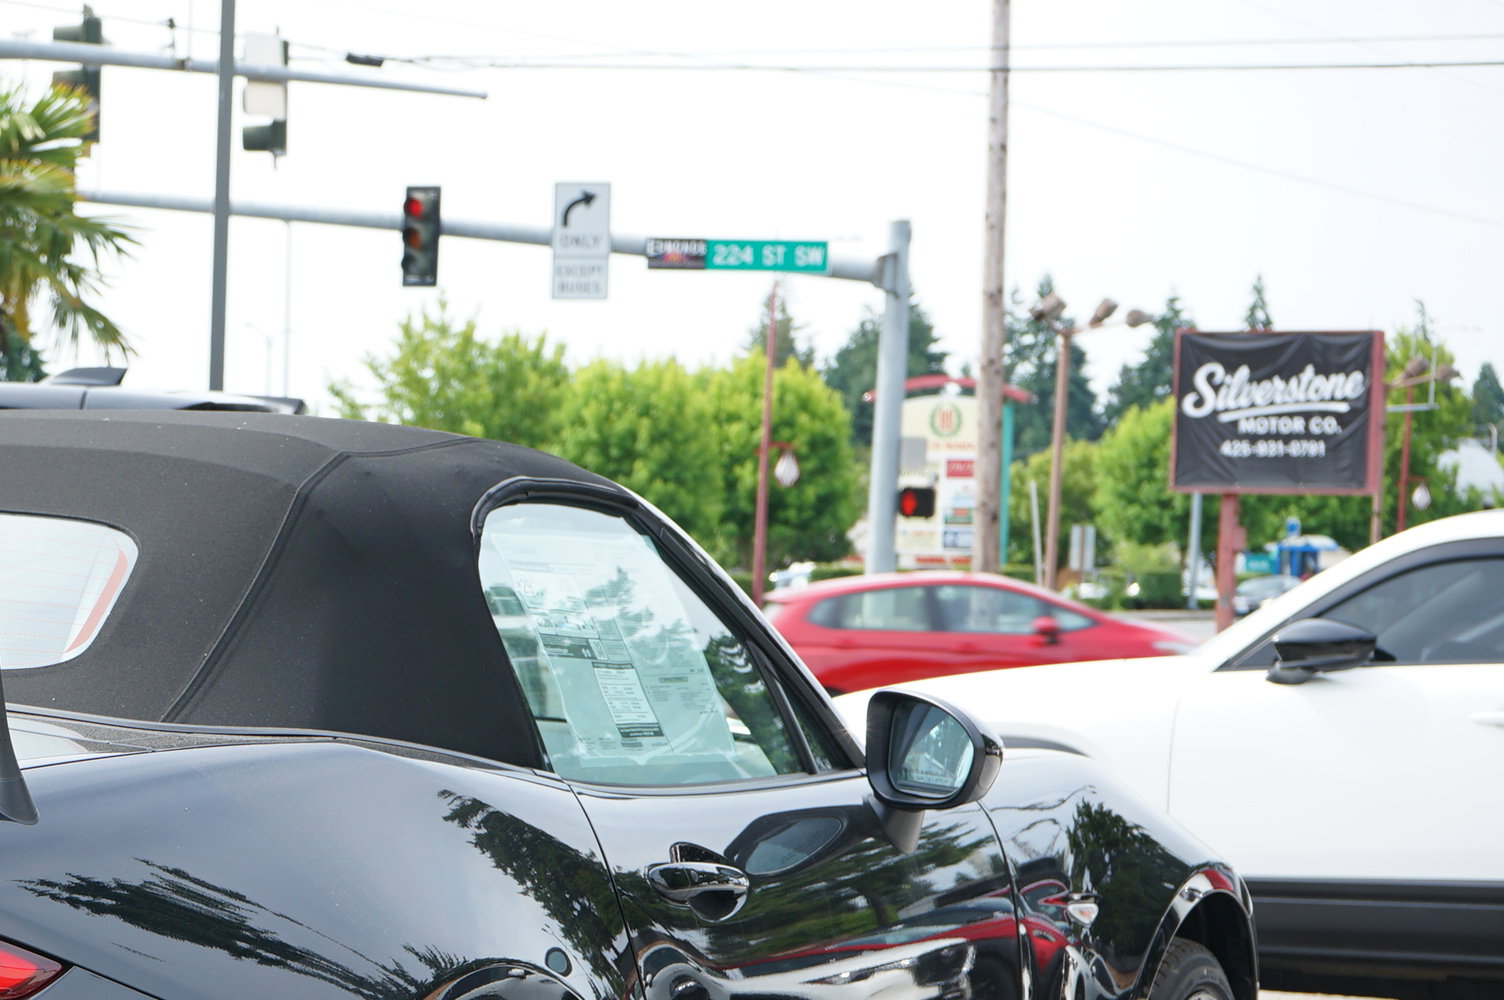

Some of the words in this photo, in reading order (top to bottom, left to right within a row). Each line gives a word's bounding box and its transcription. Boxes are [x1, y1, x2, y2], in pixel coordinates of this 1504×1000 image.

[712, 243, 754, 266] 224
[761, 245, 788, 267] ST
[794, 245, 825, 268] SW
[1181, 362, 1366, 419] Silverstone
[1237, 415, 1306, 435] MOTOR
[1308, 415, 1343, 436] CO.
